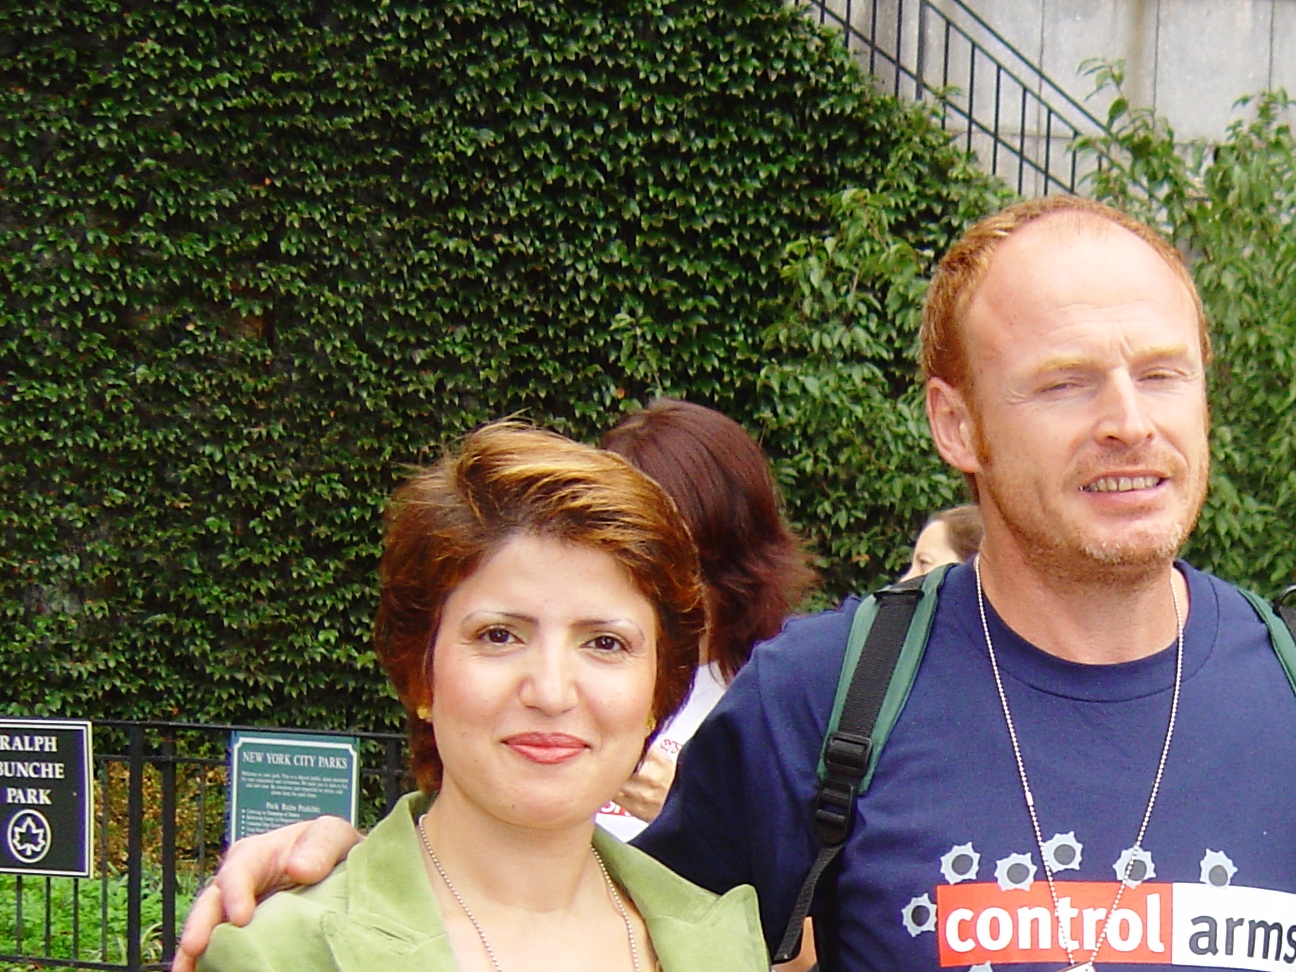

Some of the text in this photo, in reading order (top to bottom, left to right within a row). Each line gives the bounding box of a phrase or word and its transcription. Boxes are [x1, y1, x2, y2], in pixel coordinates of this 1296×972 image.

[0, 735, 57, 752] RALPH
[242, 751, 348, 769] NEW YORK CITY PARKS
[7, 787, 52, 805] PARK
[945, 893, 1165, 954] control
